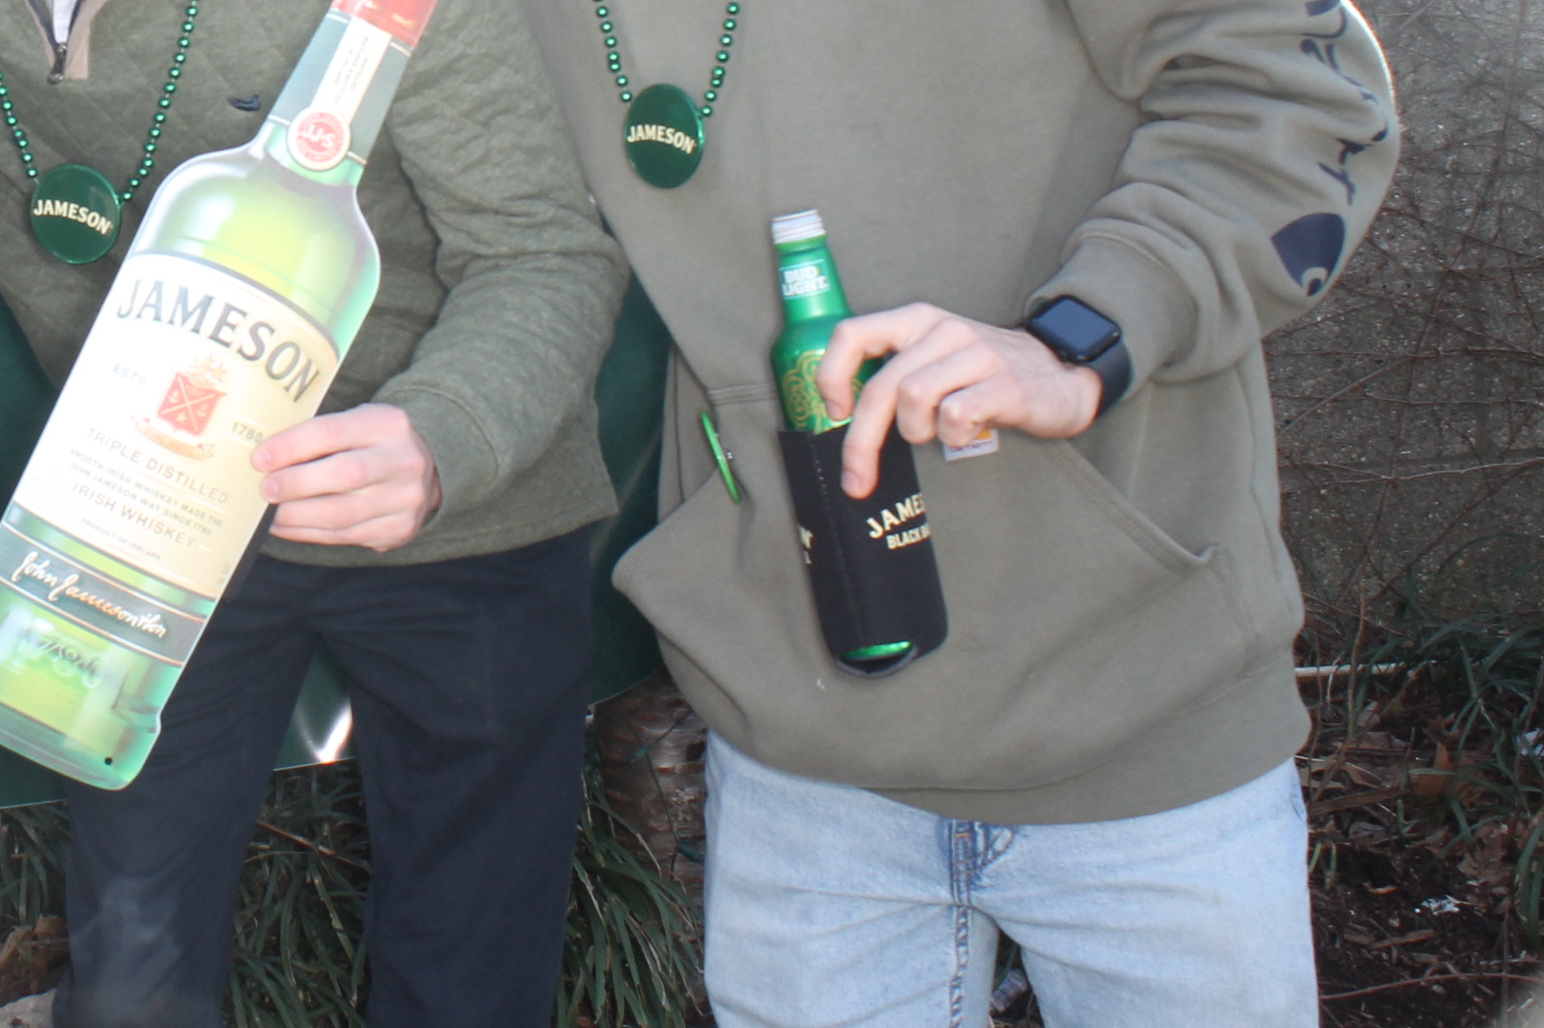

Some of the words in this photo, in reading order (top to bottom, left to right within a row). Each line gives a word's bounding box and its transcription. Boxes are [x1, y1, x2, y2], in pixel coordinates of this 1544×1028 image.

[627, 124, 696, 154] JAMESON
[33, 199, 113, 235] JAMESON
[782, 276, 830, 296] LIGHT
[784, 265, 819, 284] BUD
[116, 279, 320, 403] JAMESON
[232, 421, 263, 442] 1780
[87, 427, 143, 464] TRIPLE
[146, 457, 229, 504] DISTILLED
[69, 447, 104, 470] SMOOTH
[106, 463, 132, 484] IRISH
[134, 481, 179, 507] WHISKEY
[180, 502, 206, 519] MADE
[207, 514, 224, 528] THE
[69, 462, 91, 478] JOHN
[93, 473, 137, 500] JAMESON
[140, 498, 160, 513] WAY
[163, 509, 191, 527] SINCE
[72, 481, 117, 512] IRISH
[120, 504, 196, 548] WHISKEY
[886, 529, 921, 549] BLACK
